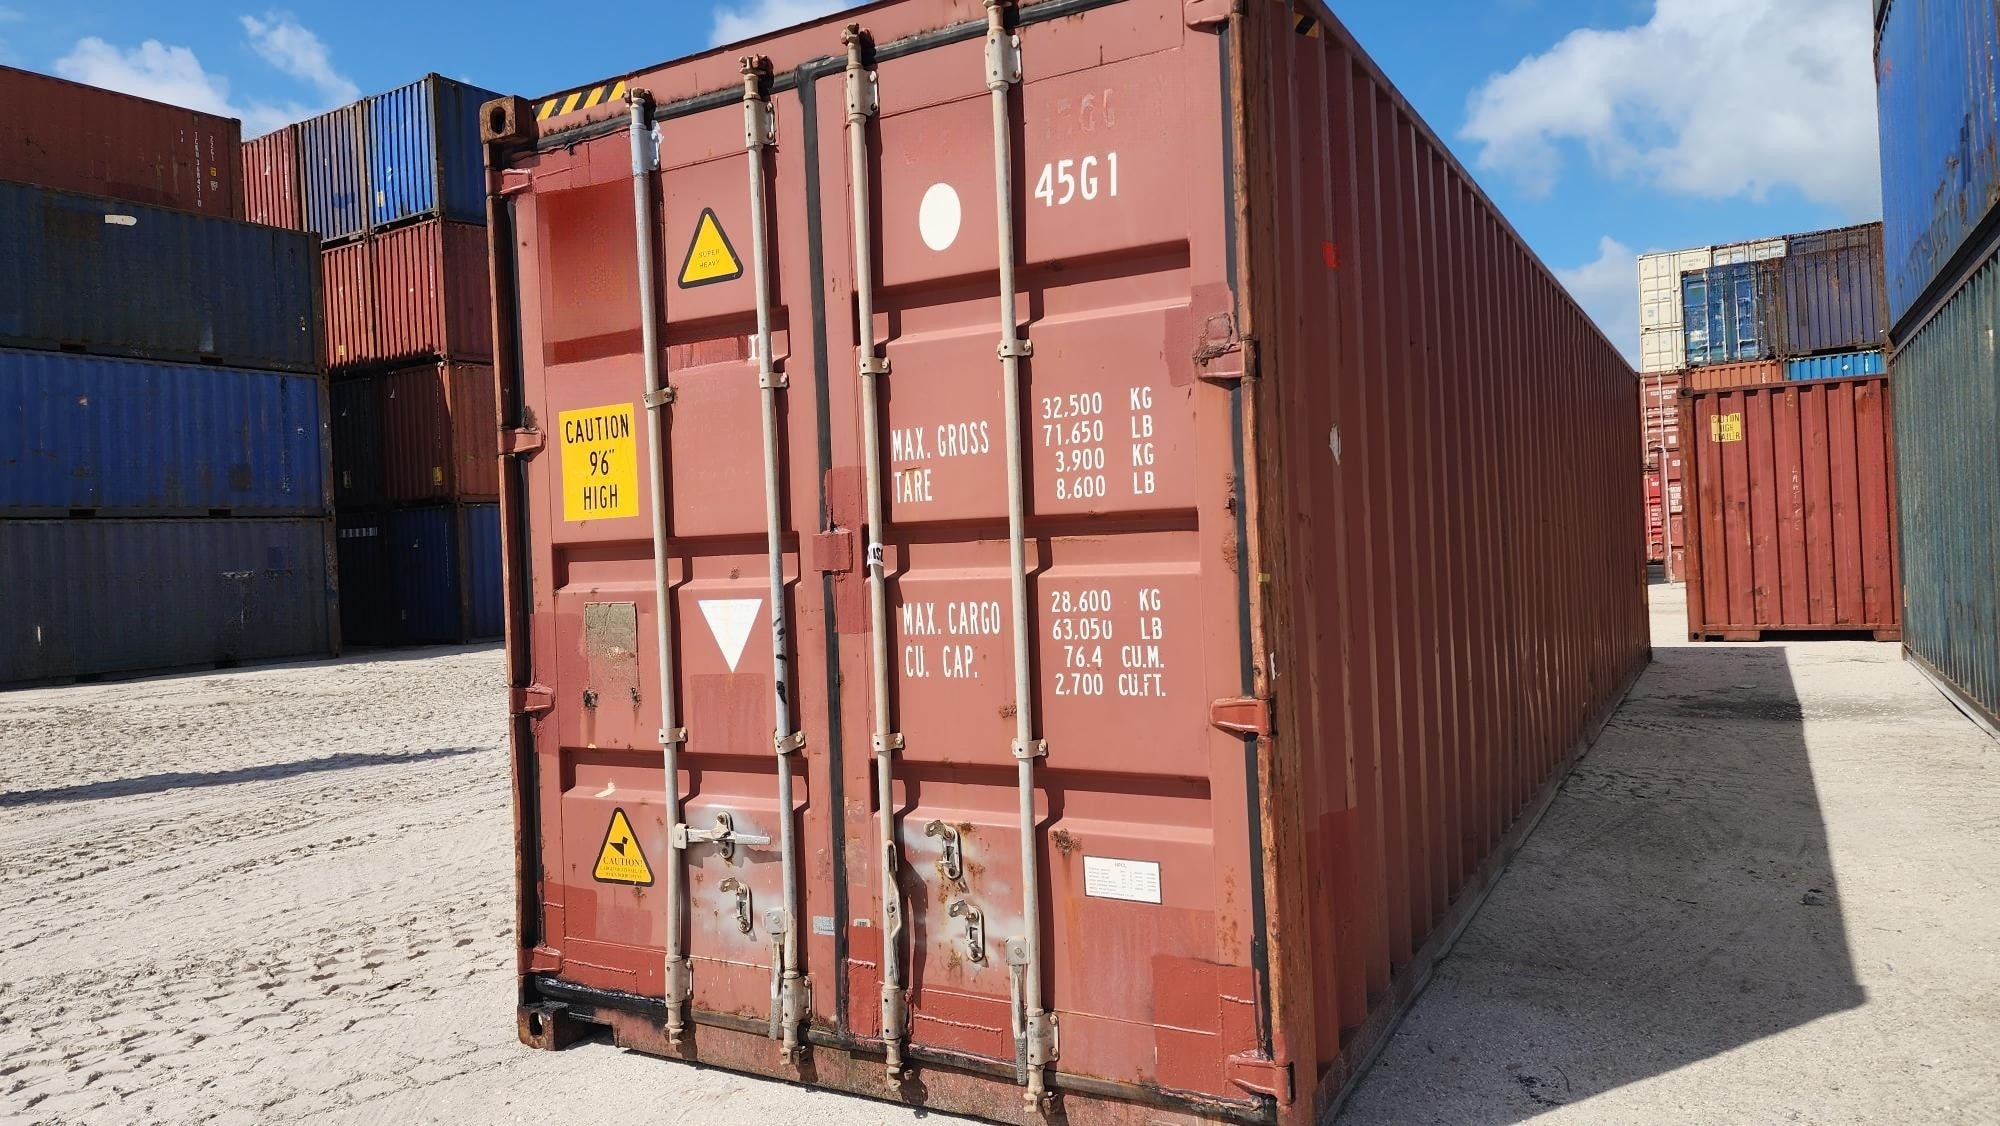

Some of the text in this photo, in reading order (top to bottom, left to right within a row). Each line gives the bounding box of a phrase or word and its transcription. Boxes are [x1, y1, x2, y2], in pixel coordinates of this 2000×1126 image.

[1034, 152, 1117, 207] 45G1
[700, 259, 720, 269] HEAVY
[1130, 386, 1152, 411] KG
[565, 413, 629, 444] CAUTION
[1132, 414, 1153, 439] LB
[892, 420, 989, 462] MAX. GROSS
[1132, 443, 1154, 467] KG
[894, 468, 933, 504] TARE
[1133, 471, 1155, 495] LB
[583, 484, 618, 510] HIGH
[1139, 588, 1161, 611] KG
[902, 601, 1000, 635] MAX. CARGO
[1140, 617, 1162, 640] LB
[905, 645, 978, 678] CU. CAP.
[1063, 645, 1165, 668] 76.4 CU.M.
[1118, 673, 1166, 697] CU.FT.
[603, 857, 643, 868] CAUTION!
